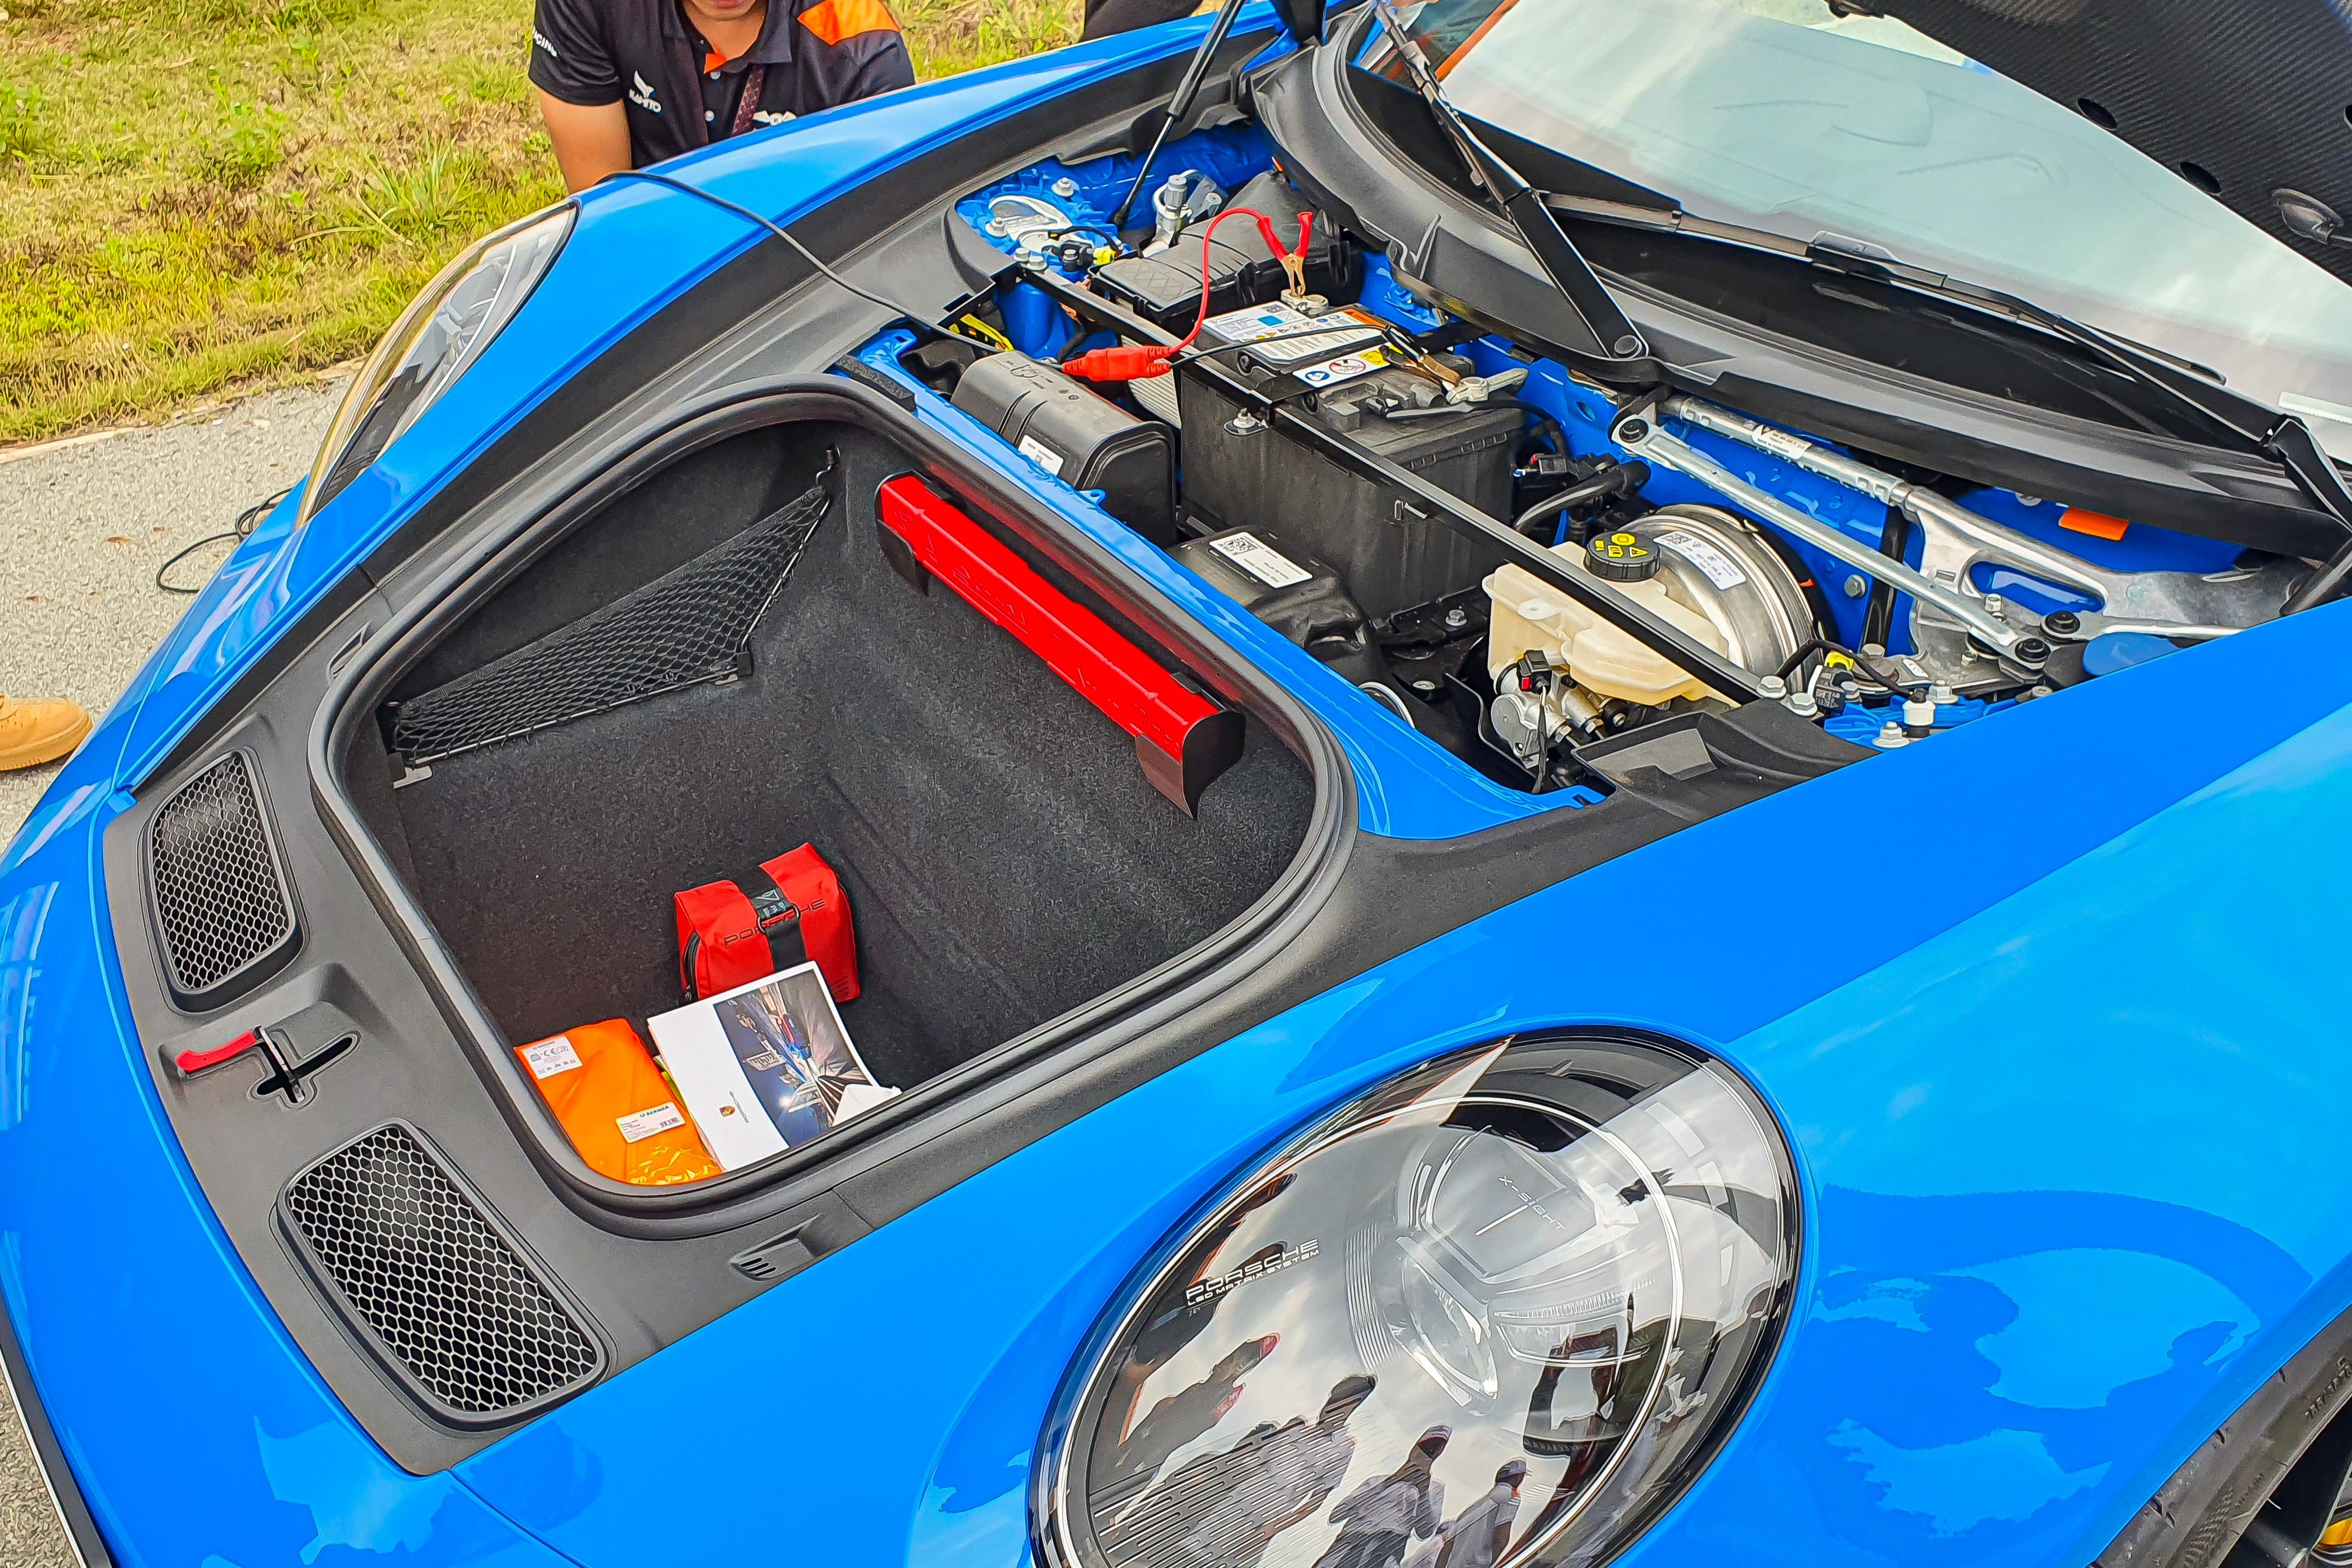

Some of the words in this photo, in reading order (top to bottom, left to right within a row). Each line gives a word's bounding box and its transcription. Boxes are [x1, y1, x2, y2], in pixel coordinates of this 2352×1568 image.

[1498, 1175, 1566, 1230] X-SIGHT
[1186, 1238, 1319, 1300] PORSCHE
[1188, 1292, 1213, 1306] LED
[1216, 1272, 1264, 1294] MATRIX
[1266, 1249, 1320, 1273] SYSTEM
